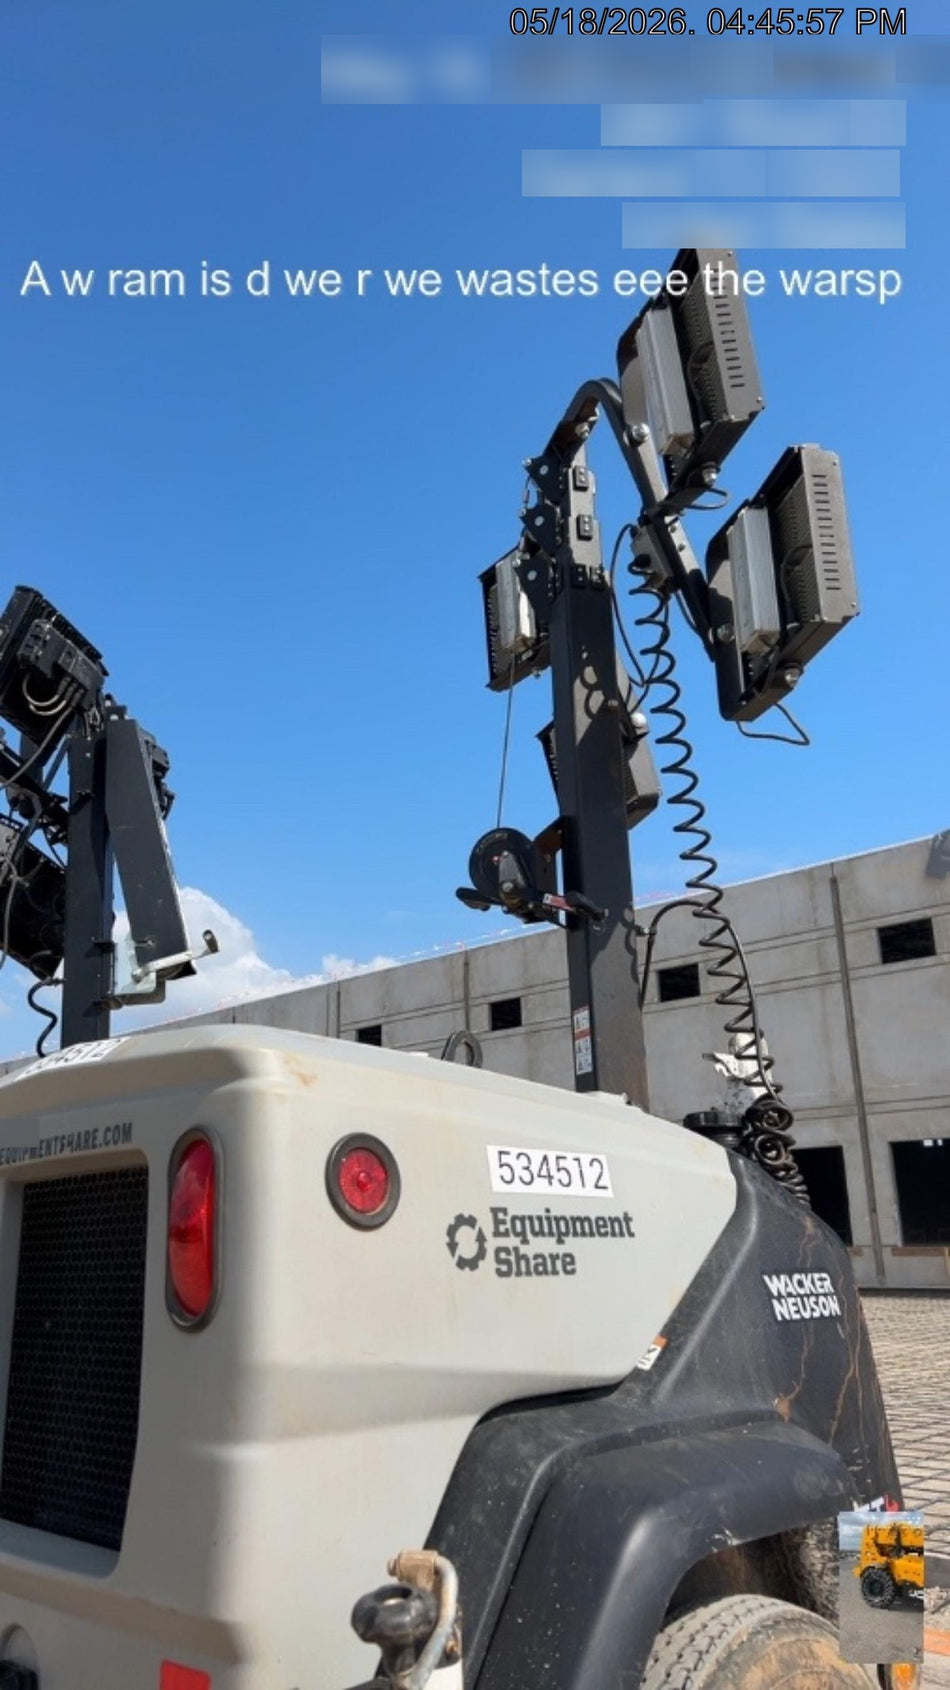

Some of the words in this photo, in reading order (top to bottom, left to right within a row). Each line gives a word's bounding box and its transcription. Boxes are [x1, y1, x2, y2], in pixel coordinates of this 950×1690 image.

[497, 1150, 608, 1190] 534512
[489, 1207, 635, 1245] Equipment
[494, 1246, 577, 1278] Share
[762, 1272, 835, 1297] WACKER
[771, 1295, 842, 1322] NEUSON
